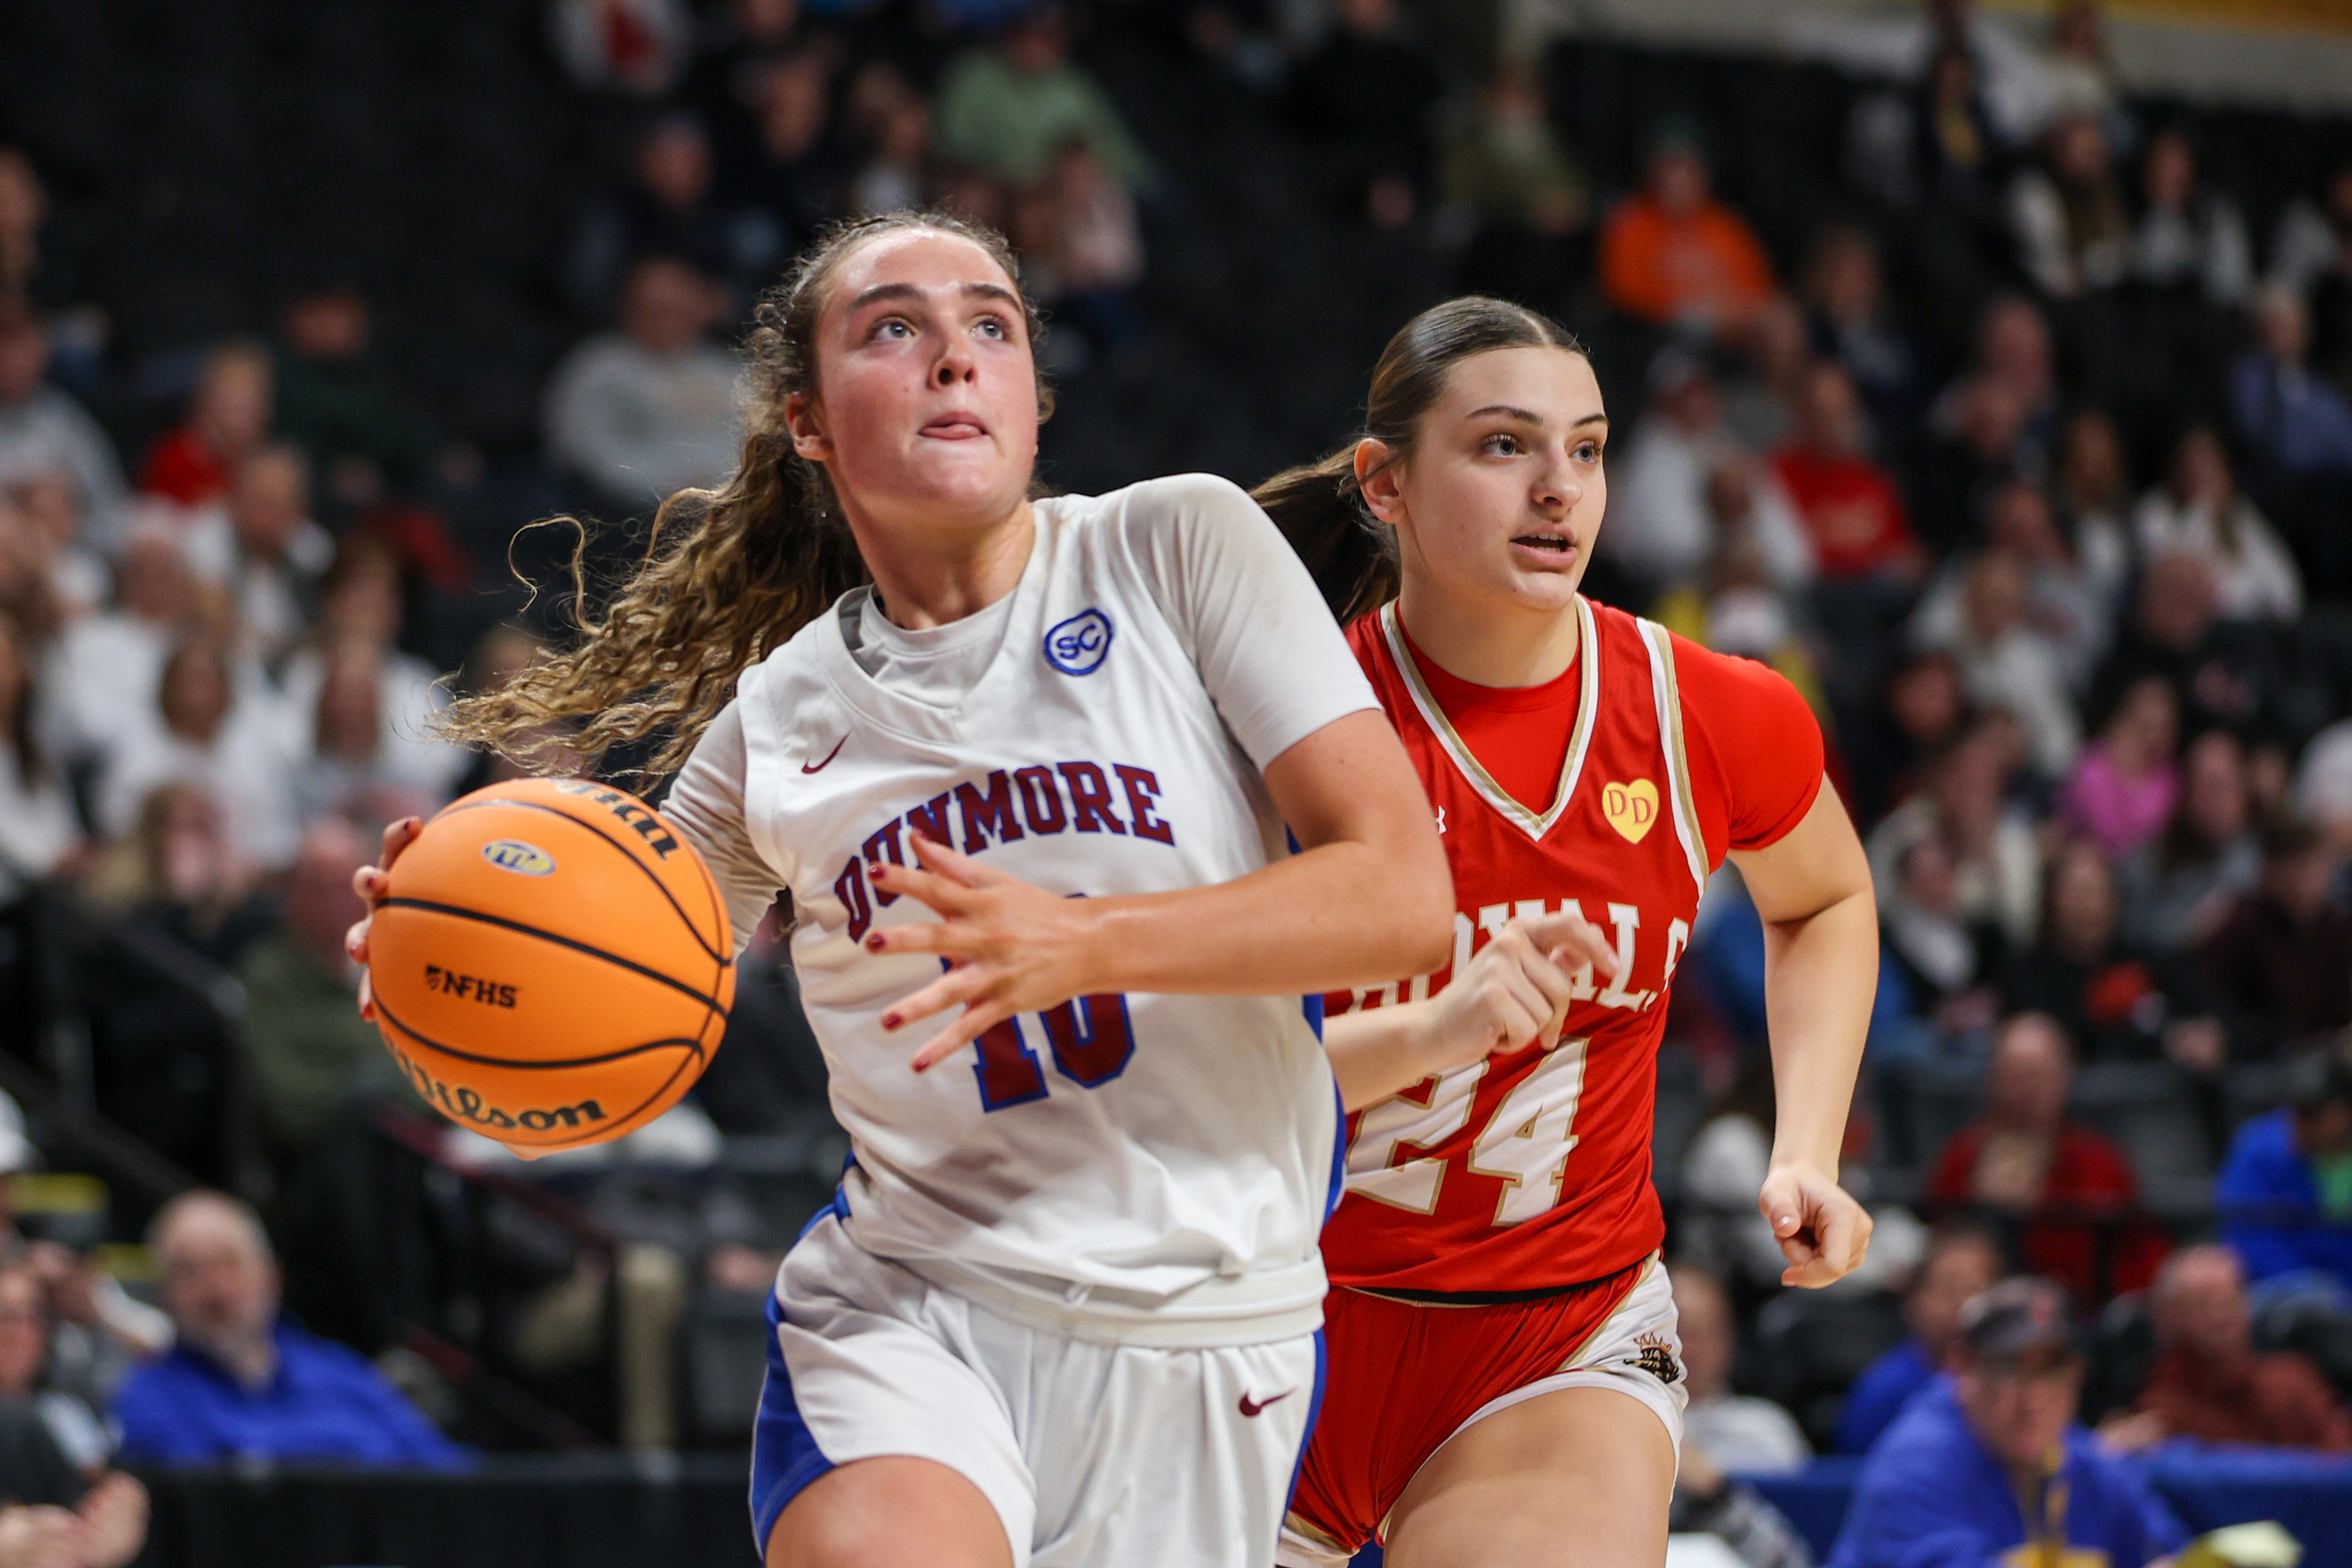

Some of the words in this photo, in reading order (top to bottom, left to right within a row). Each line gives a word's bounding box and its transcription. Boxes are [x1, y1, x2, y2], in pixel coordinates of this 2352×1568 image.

[1057, 623, 1101, 659] SC
[834, 760, 1176, 943] DUNMORE
[442, 970, 517, 1008] NFHS
[1351, 898, 1690, 1011] ALS
[387, 1036, 607, 1131] Wilson
[1345, 1036, 1591, 1227] 24
